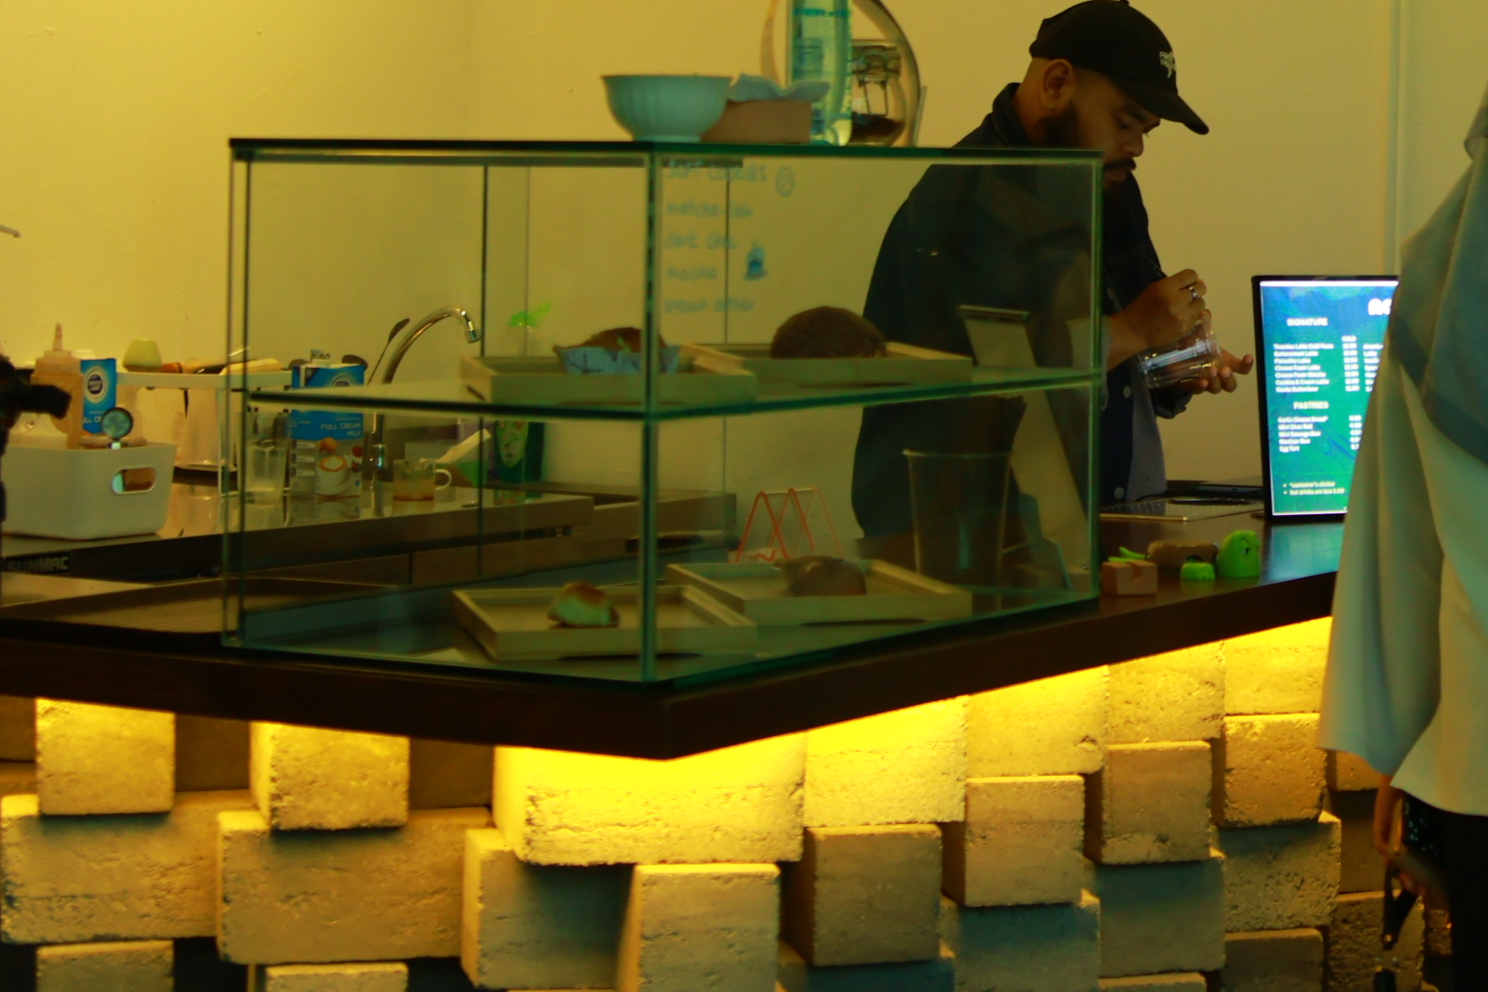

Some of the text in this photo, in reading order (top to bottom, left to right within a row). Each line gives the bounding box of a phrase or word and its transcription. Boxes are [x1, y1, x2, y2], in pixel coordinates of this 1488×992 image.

[1287, 318, 1328, 326] SIGNATURE
[1293, 401, 1329, 410] PASTRIES
[320, 423, 338, 431] FULL
